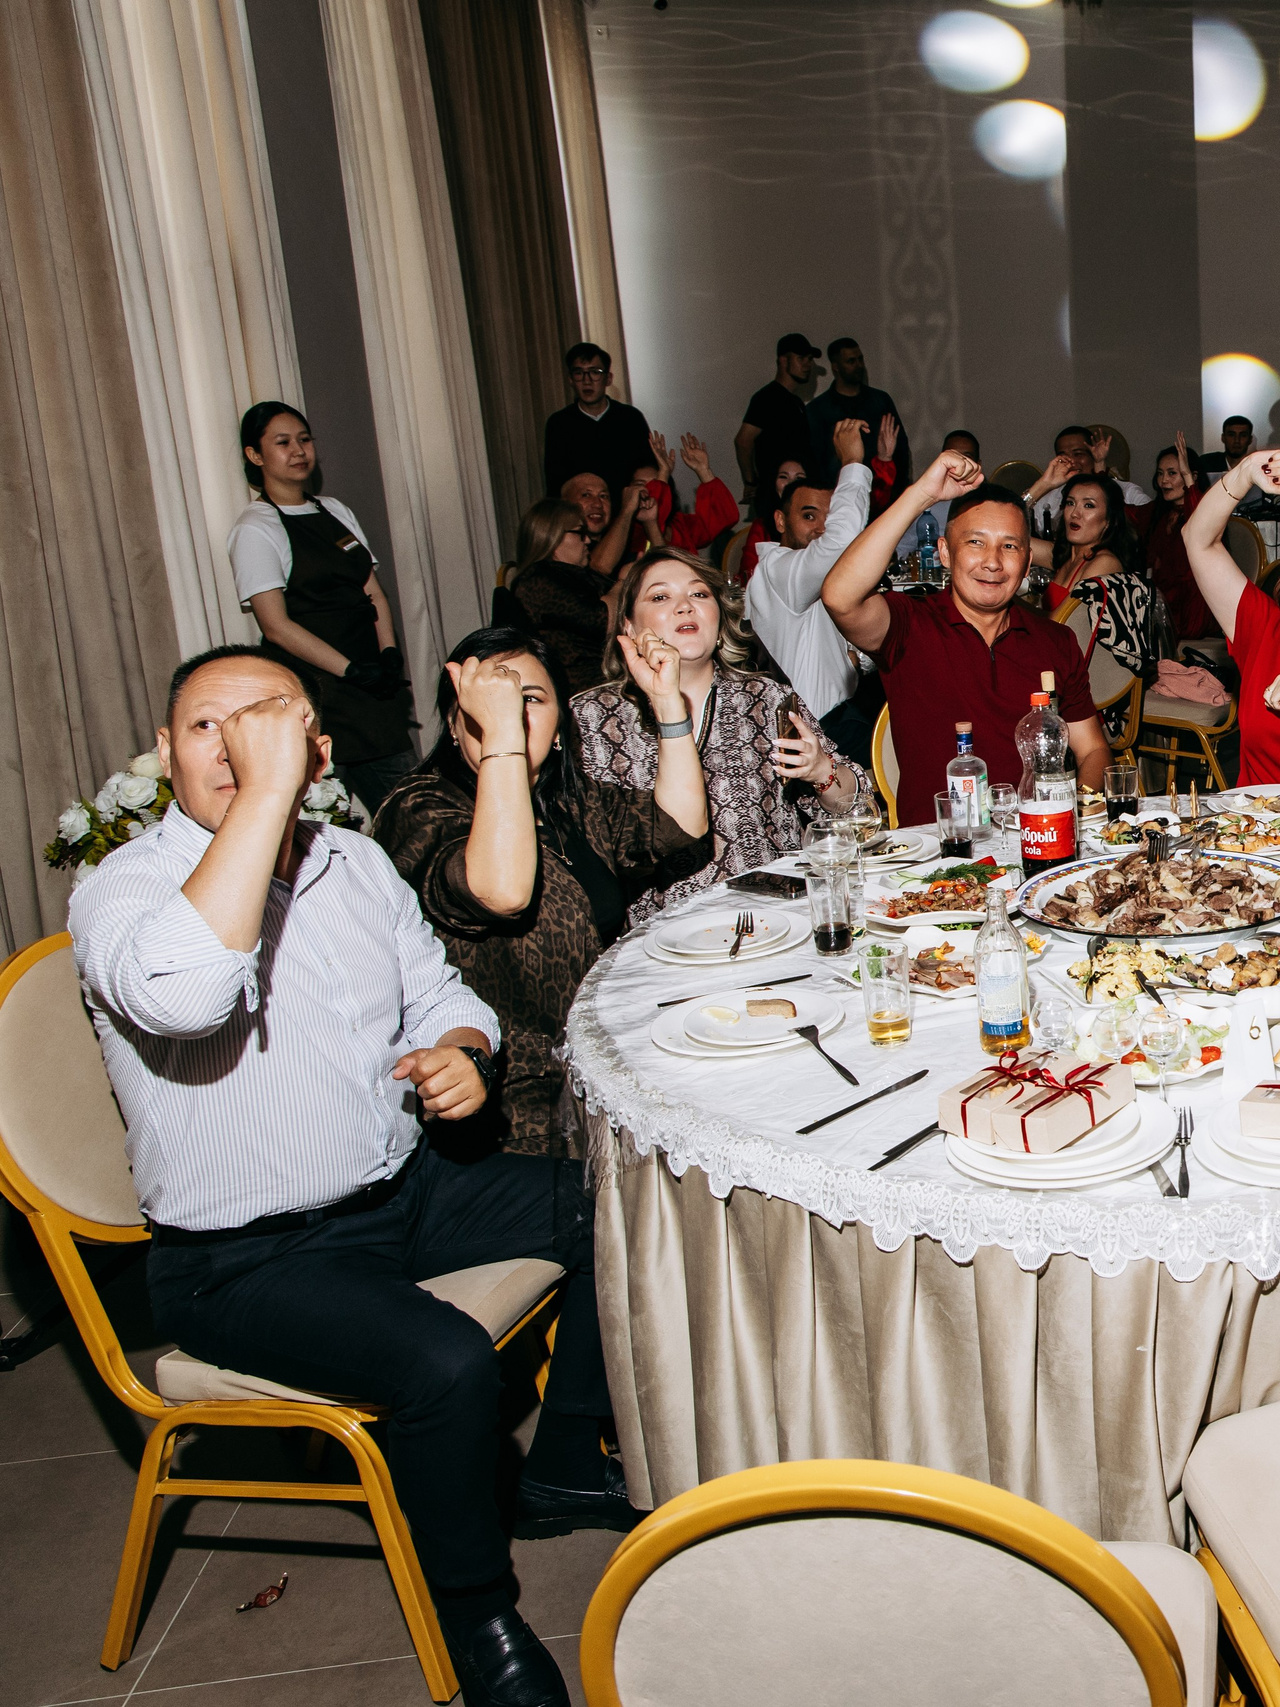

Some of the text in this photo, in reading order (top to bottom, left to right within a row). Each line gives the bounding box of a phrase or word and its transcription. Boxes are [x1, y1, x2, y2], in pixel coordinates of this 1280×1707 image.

[1021, 827, 1058, 845] обрый
[1024, 845, 1042, 855] cola
[1249, 1015, 1261, 1040] 6
